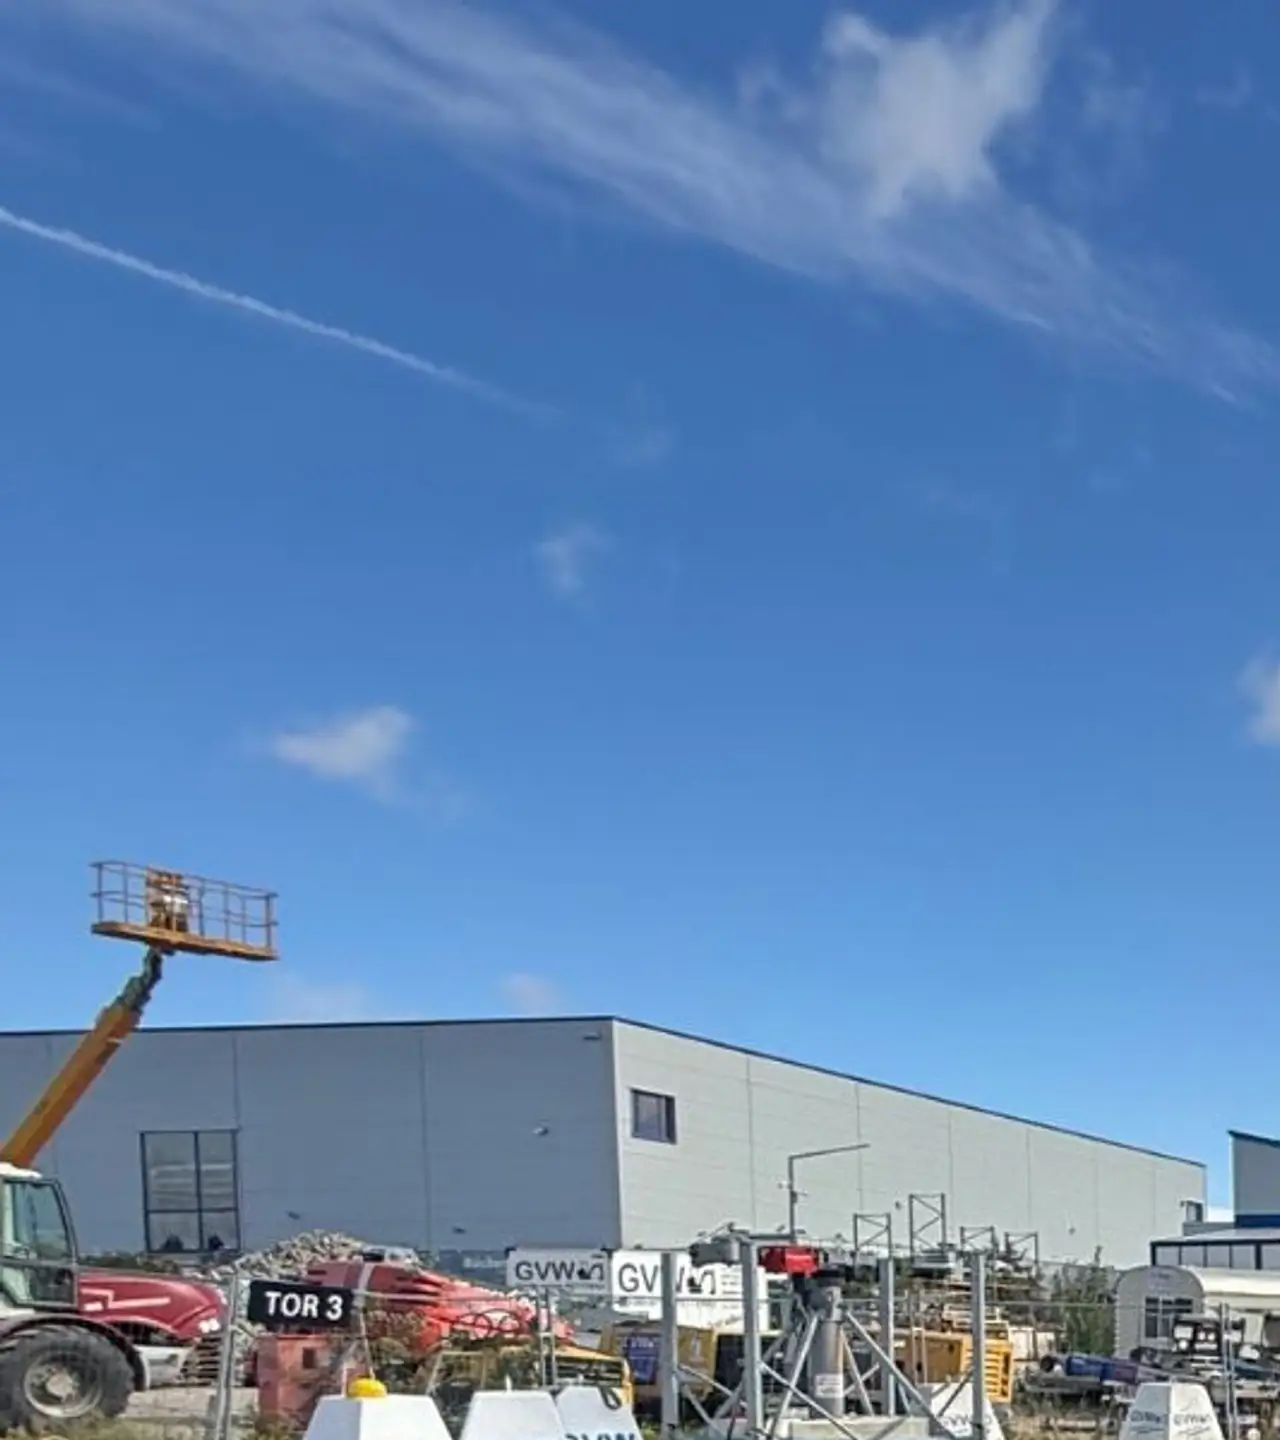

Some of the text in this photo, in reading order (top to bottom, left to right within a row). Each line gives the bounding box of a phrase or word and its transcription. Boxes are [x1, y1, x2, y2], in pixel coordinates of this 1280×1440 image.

[515, 1259, 575, 1281] GVW
[264, 1290, 344, 1321] TOR 3
